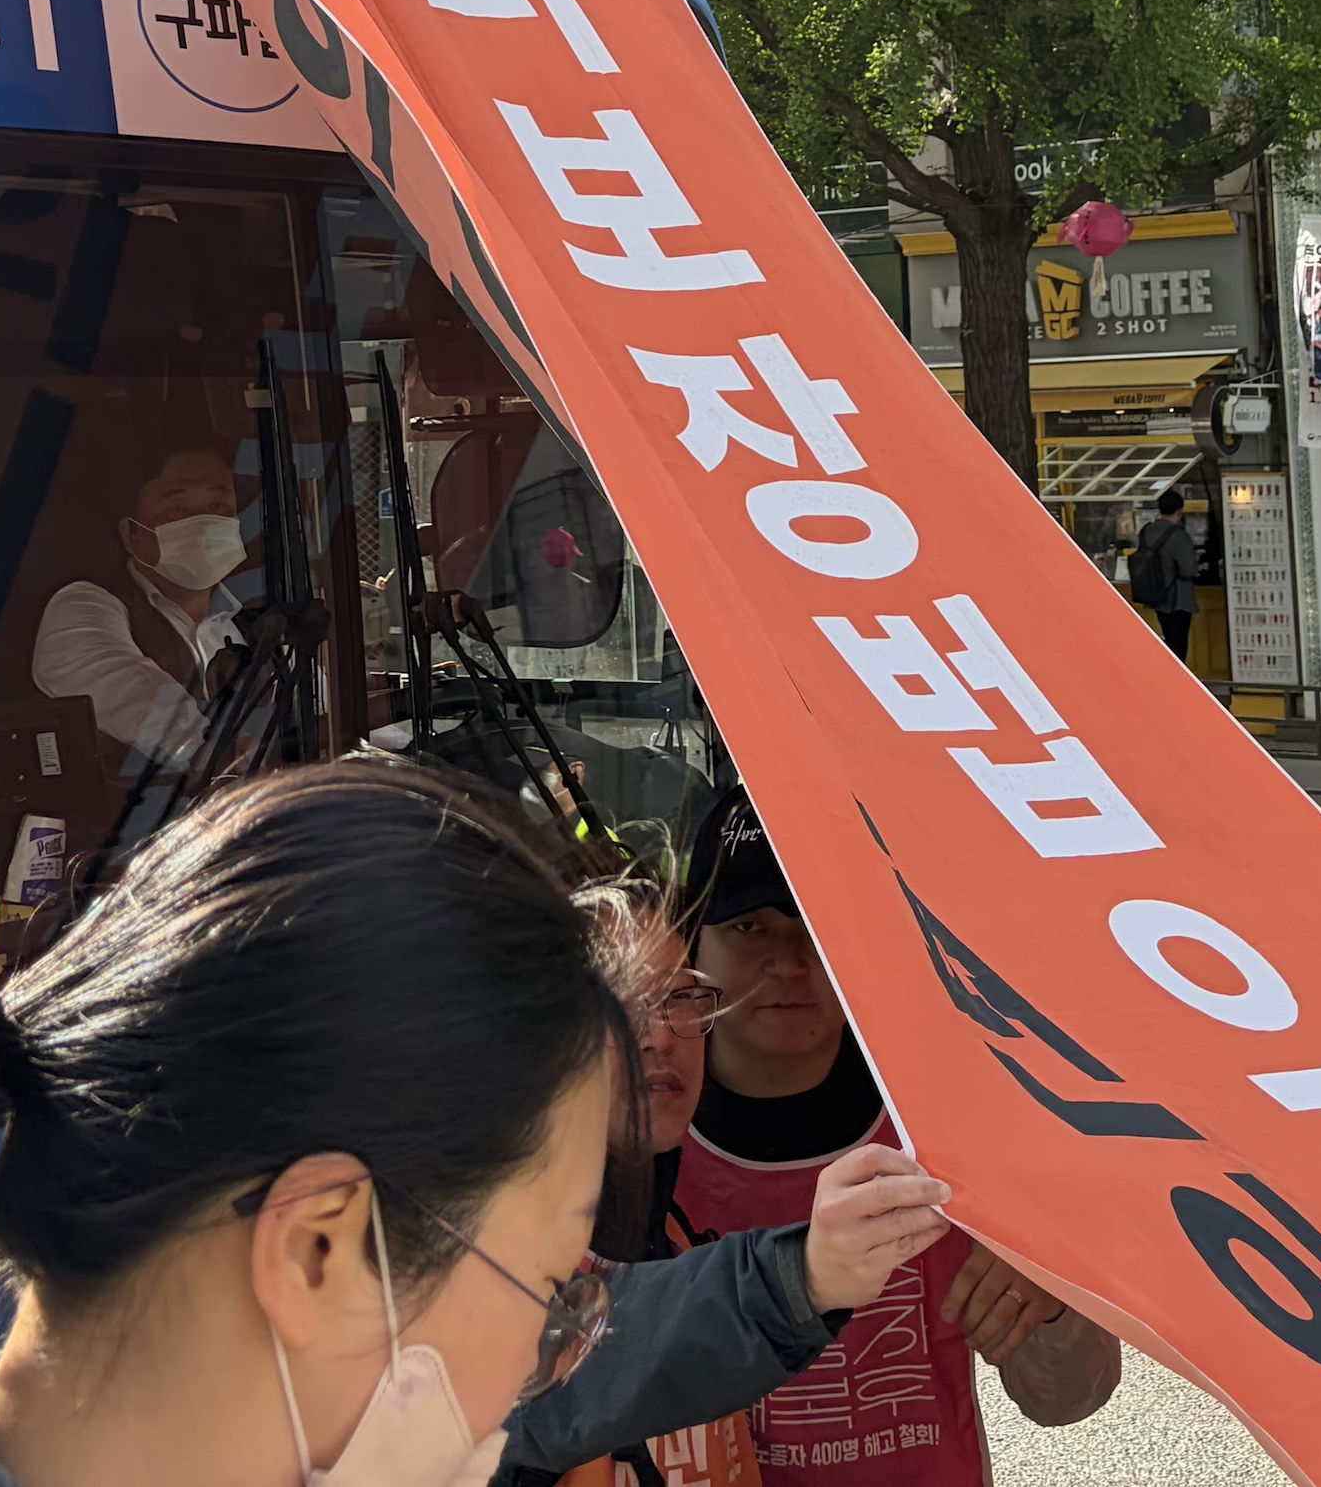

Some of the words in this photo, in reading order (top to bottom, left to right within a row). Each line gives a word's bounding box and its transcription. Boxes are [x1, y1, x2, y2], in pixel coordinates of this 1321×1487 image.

[930, 280, 1040, 329] MA
[1089, 269, 1214, 319] COFFEE
[1096, 322, 1108, 337] 2
[1114, 318, 1168, 336] SHOT
[810, 1437, 861, 1466] 400명
[863, 1428, 898, 1457] 해고
[898, 1422, 941, 1449] 철회!
